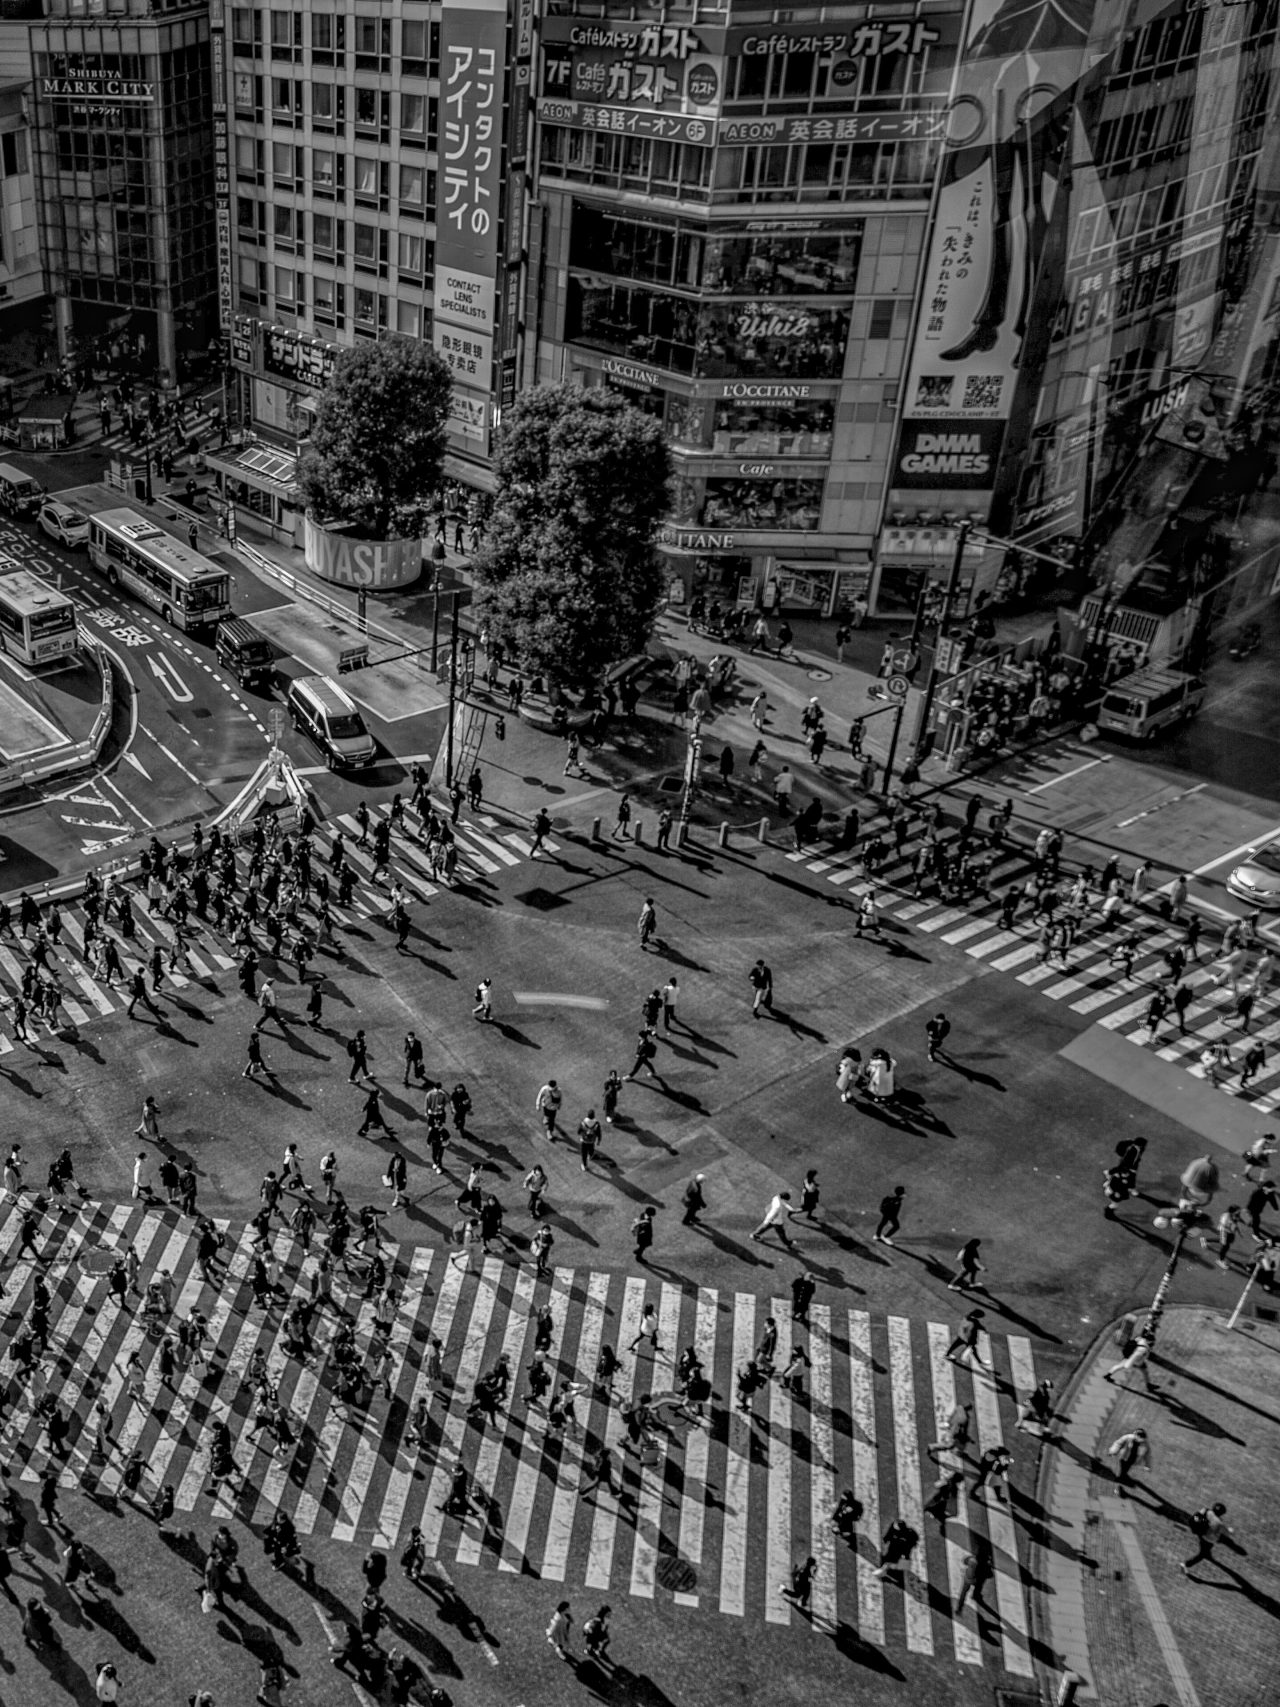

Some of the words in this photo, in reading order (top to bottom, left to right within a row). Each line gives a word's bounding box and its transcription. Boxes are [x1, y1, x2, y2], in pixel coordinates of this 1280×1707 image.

[640, 25, 698, 59] ガスト
[851, 23, 939, 56] ガスト
[69, 67, 122, 79] SHIBUYA
[546, 58, 571, 84] 7F
[576, 62, 605, 80] Café
[607, 60, 677, 103] ガスト
[44, 79, 98, 94] MARK
[107, 80, 154, 96] CITY
[543, 103, 572, 118] AEON
[582, 107, 681, 136] 英会話イーオン
[444, 45, 474, 230] アイシティ
[726, 124, 776, 140] AEON
[788, 115, 946, 141] 英会話イーオン
[470, 48, 496, 235] コンタクトの
[446, 276, 482, 295] CONTACT
[454, 290, 473, 304] LENS
[440, 298, 487, 320] SPECIALISTS
[269, 331, 338, 379] サンドラッ
[446, 352, 478, 375] 专卖店
[601, 359, 660, 386] L'OCCITANE
[723, 382, 810, 398] L'OCCITANE
[1140, 381, 1191, 426] LUSH
[914, 433, 981, 453] DMM
[900, 453, 991, 474] GAMES
